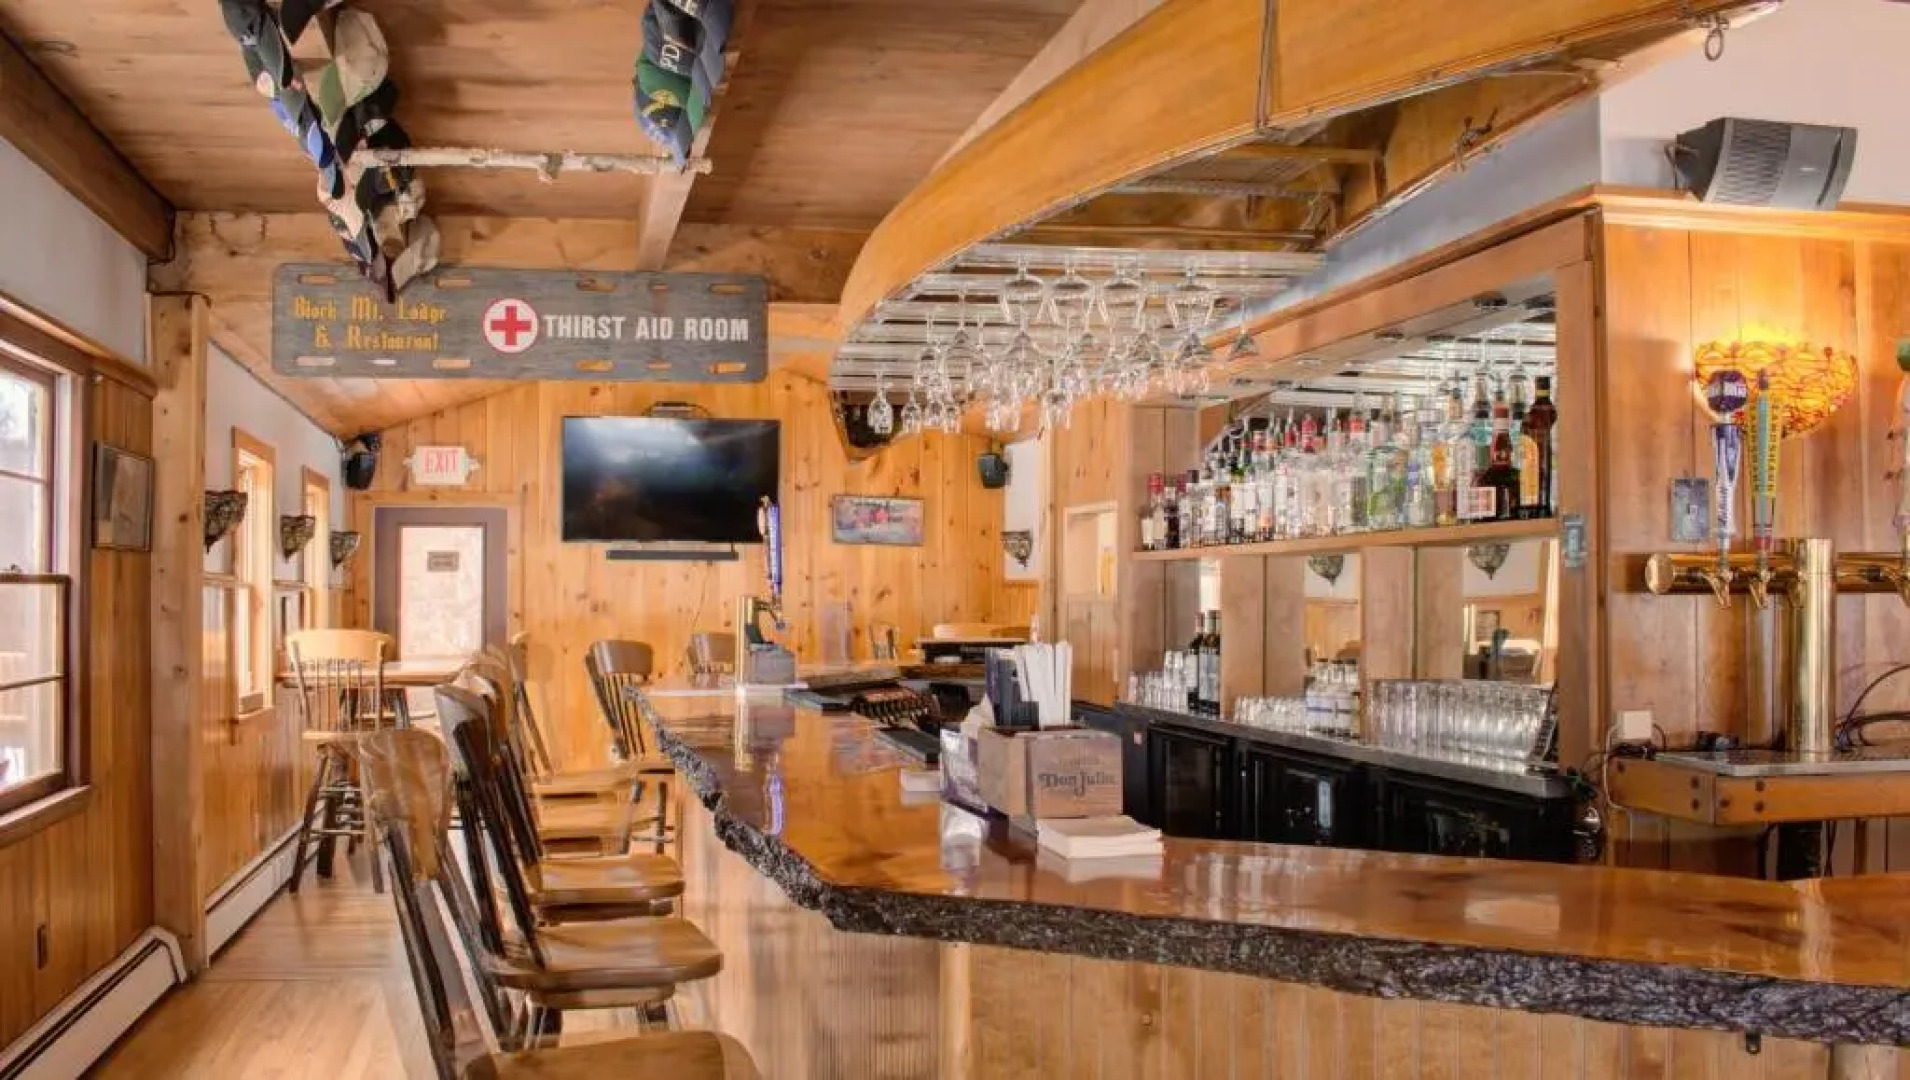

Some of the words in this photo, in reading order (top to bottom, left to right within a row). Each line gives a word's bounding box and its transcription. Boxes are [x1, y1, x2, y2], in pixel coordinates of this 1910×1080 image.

[347, 323, 439, 351] Restaurant
[543, 314, 627, 340] THIRST
[634, 316, 675, 341] AID
[683, 316, 750, 342] ROOM
[423, 450, 460, 474] EXIT
[1038, 773, 1077, 789] Don
